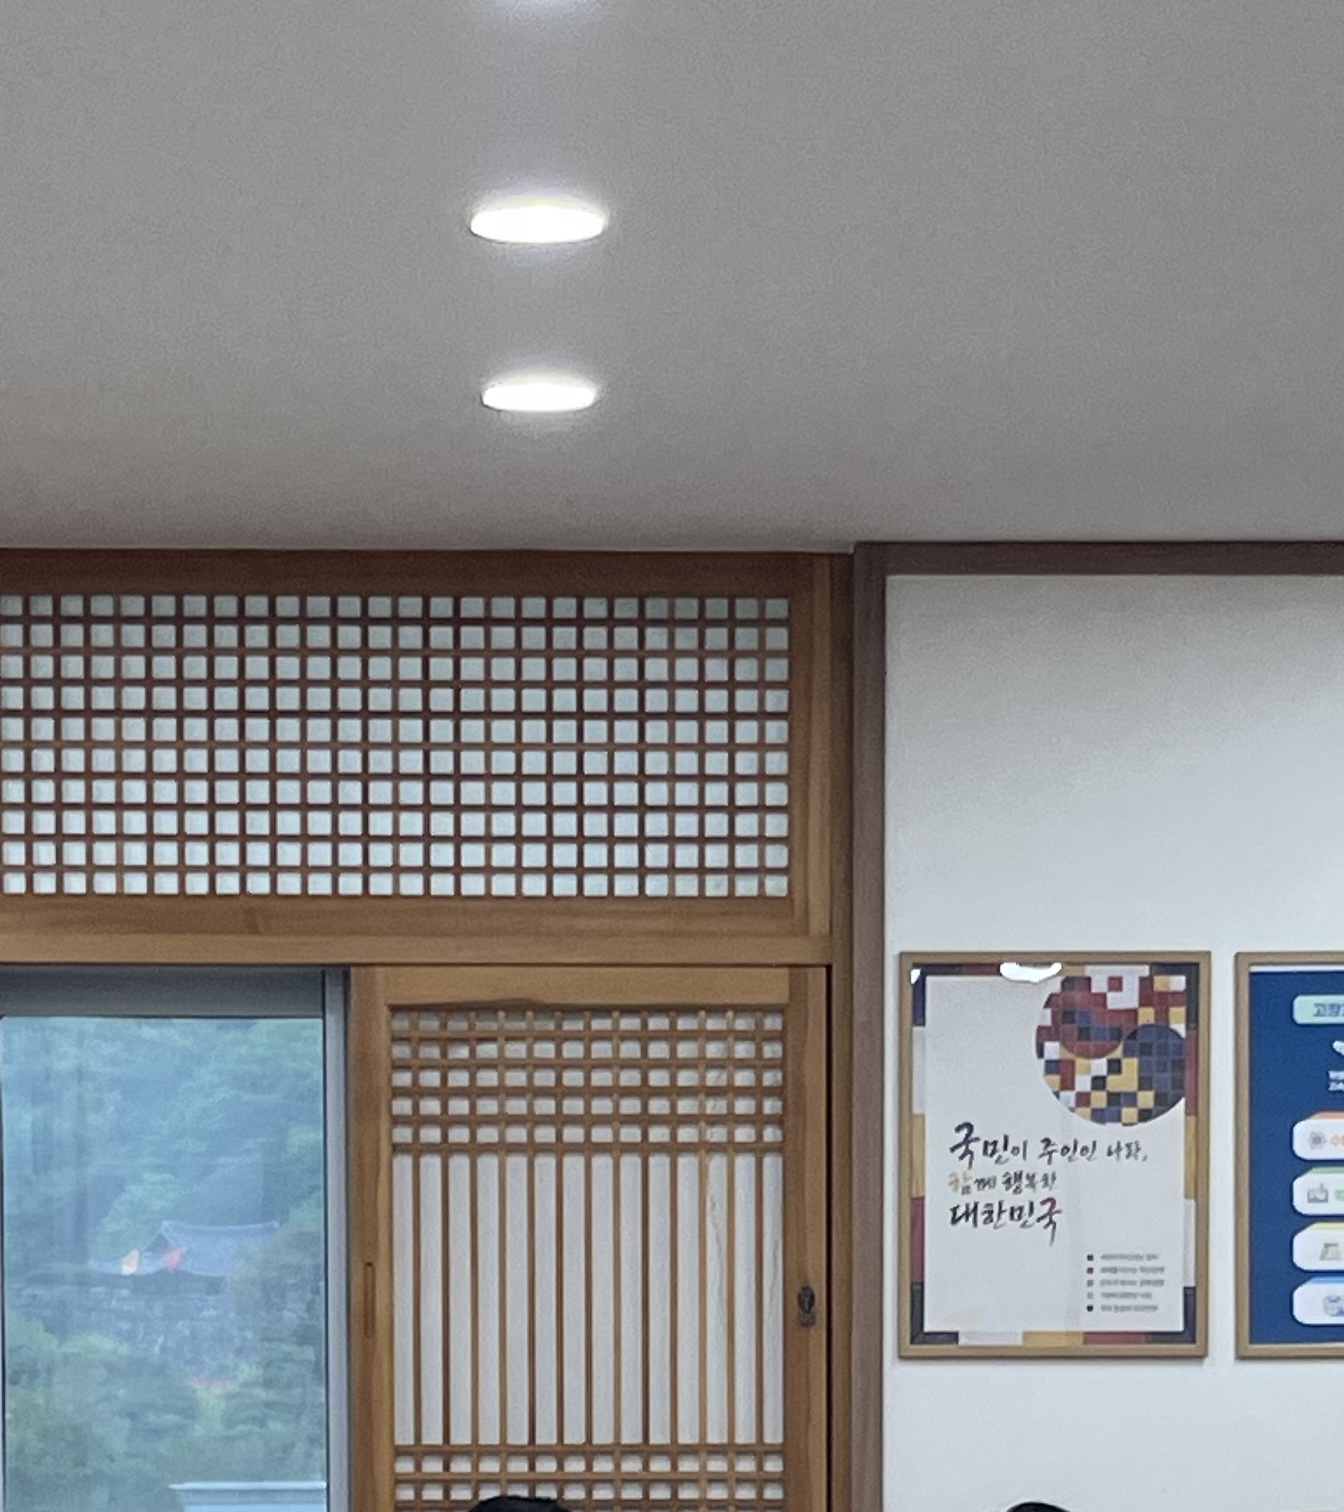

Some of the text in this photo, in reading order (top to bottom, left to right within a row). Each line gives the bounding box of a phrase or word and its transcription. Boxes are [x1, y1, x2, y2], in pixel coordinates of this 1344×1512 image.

[949, 1121, 1028, 1171] 국민이
[1038, 1137, 1097, 1165] 주인인
[949, 1197, 1063, 1247] 대한민국
